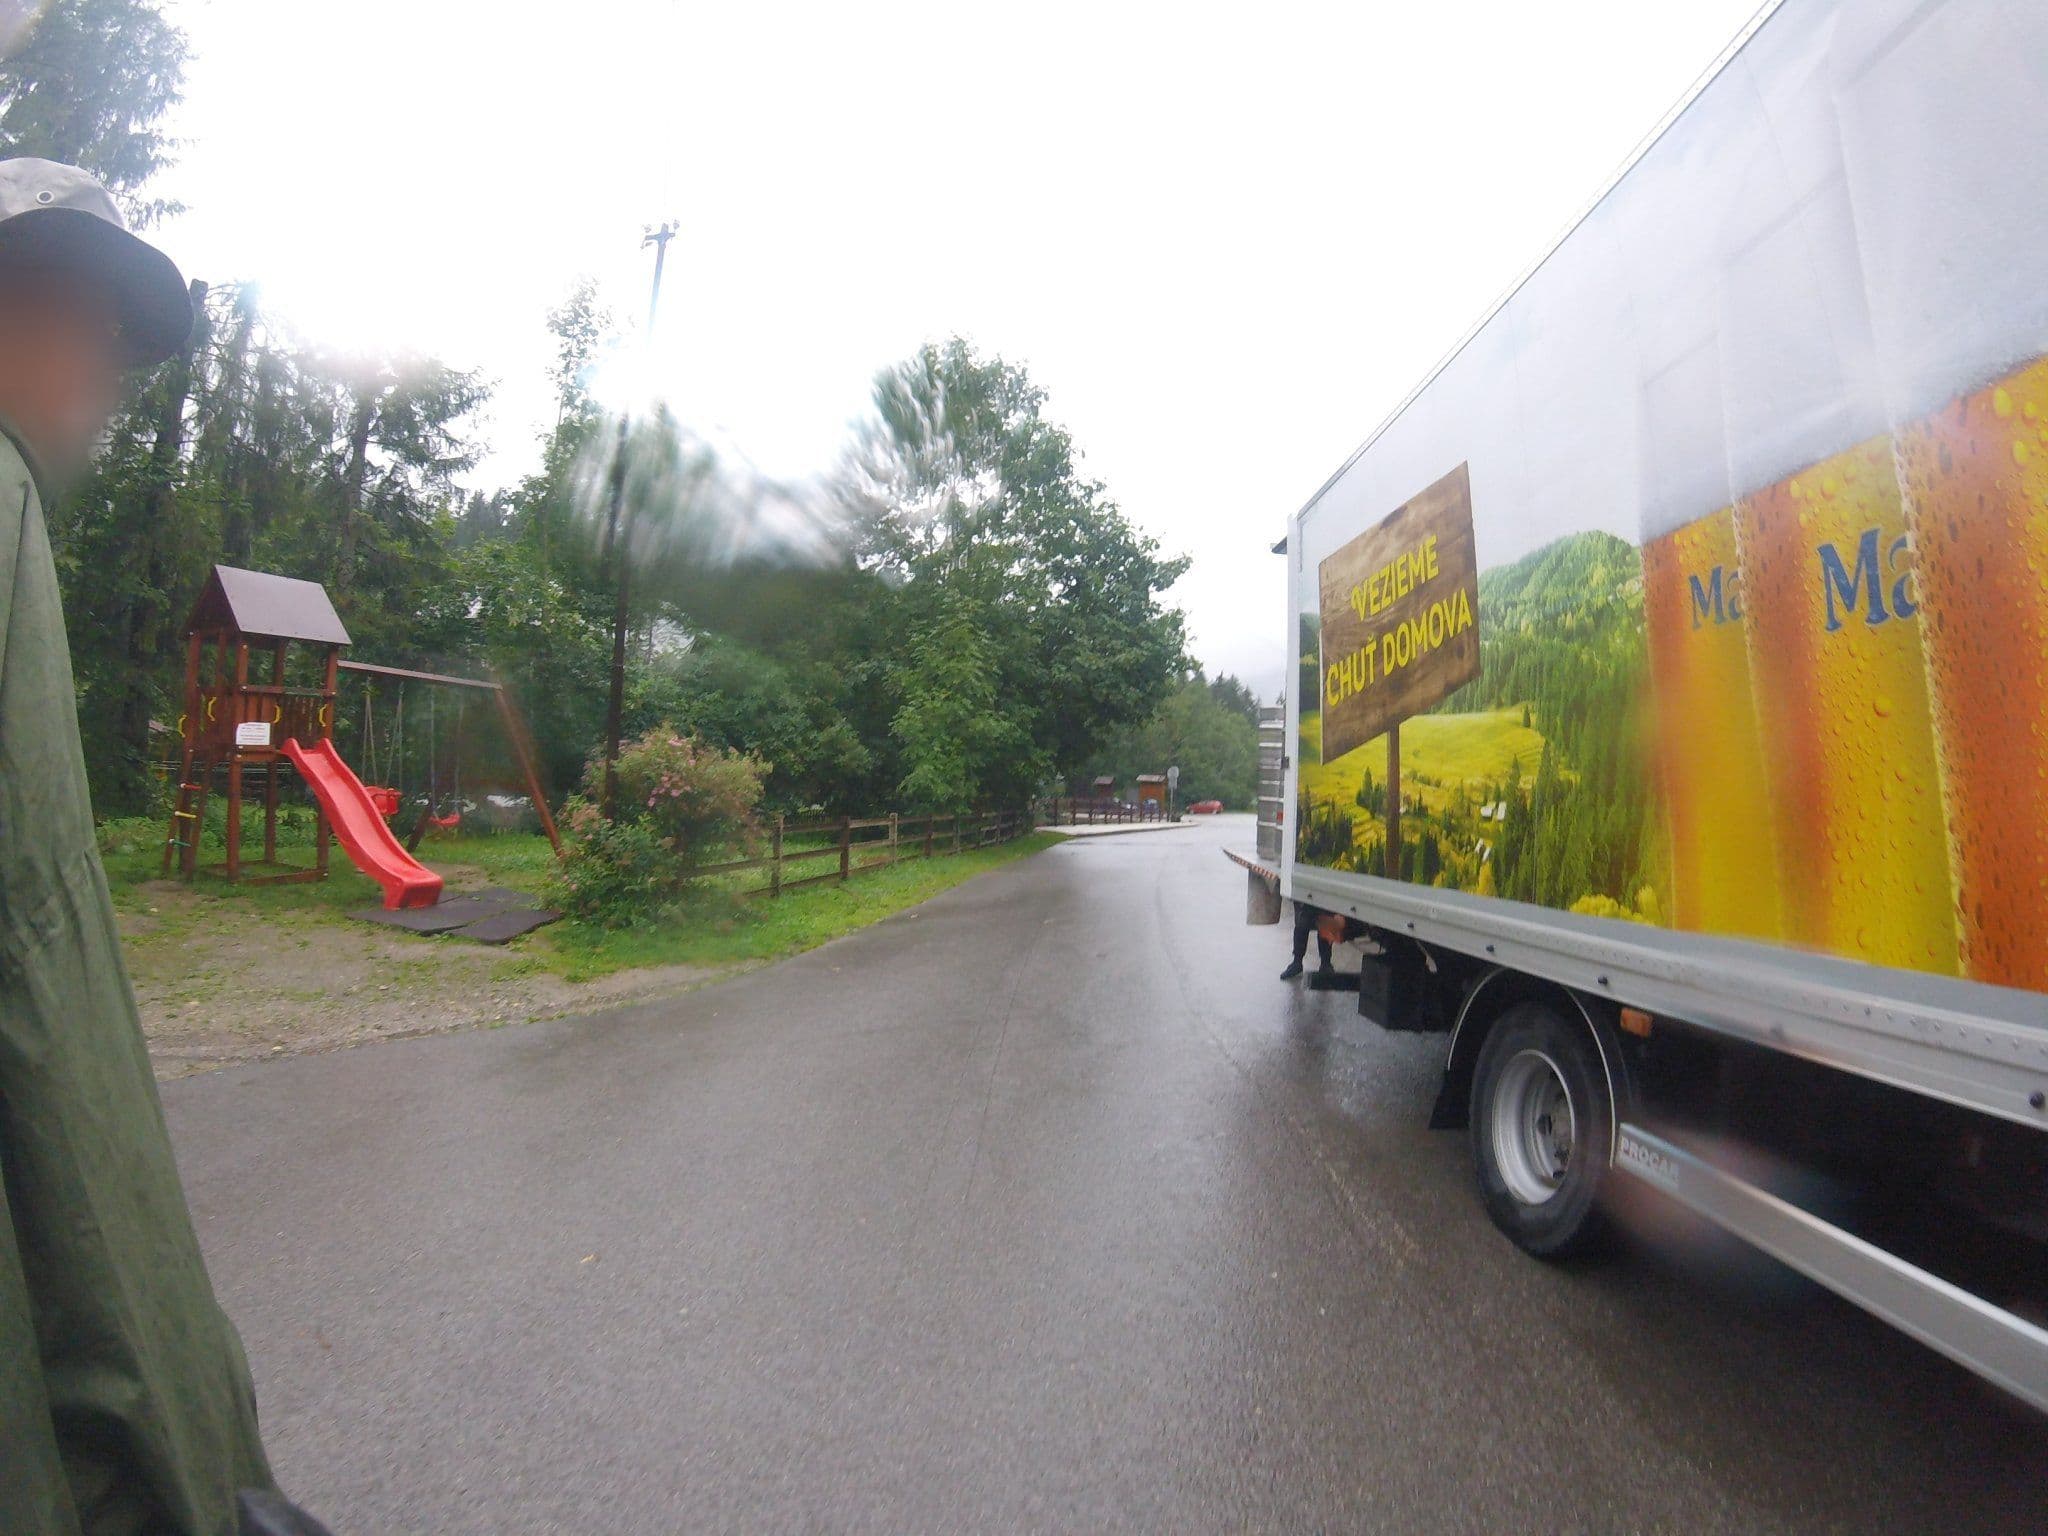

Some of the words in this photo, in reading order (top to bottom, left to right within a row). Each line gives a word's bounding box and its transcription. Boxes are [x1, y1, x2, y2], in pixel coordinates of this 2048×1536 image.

[1352, 534, 1439, 621] VEZIEME
[1325, 634, 1377, 706] CHUŤ
[1383, 588, 1472, 676] DOMOVA
